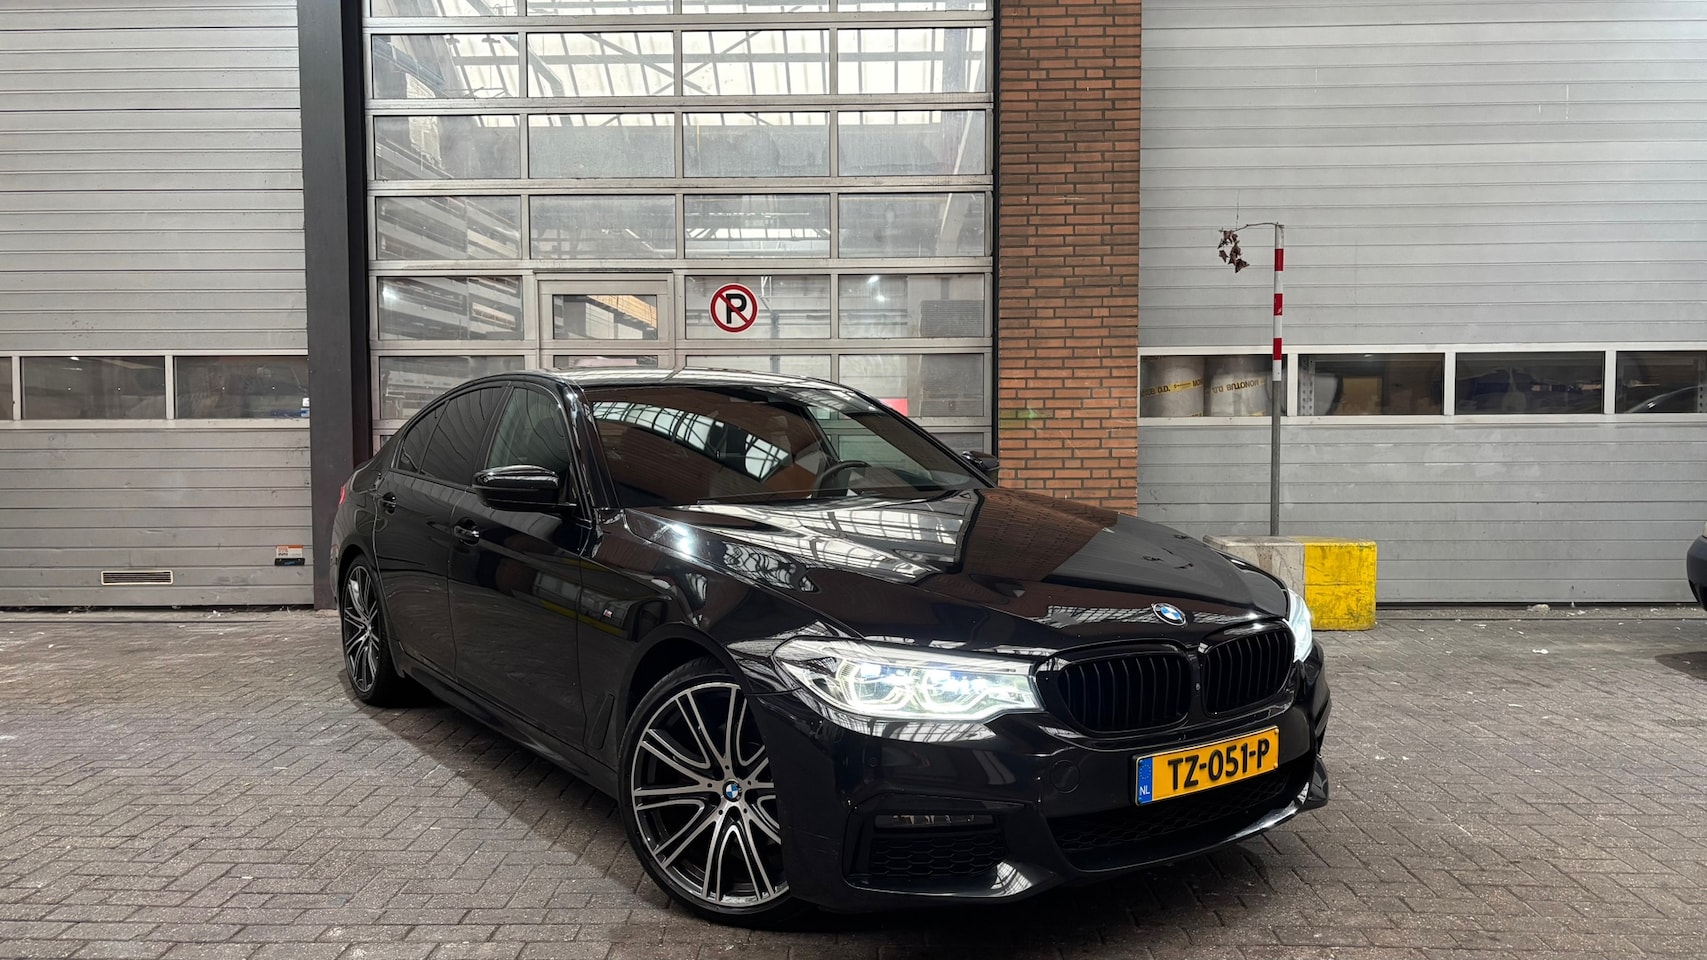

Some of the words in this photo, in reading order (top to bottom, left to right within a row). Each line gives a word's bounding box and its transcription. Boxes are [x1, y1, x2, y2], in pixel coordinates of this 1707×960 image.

[726, 293, 747, 324] P
[1167, 738, 1270, 791] TZ-051-P
[1139, 785, 1150, 796] NL
